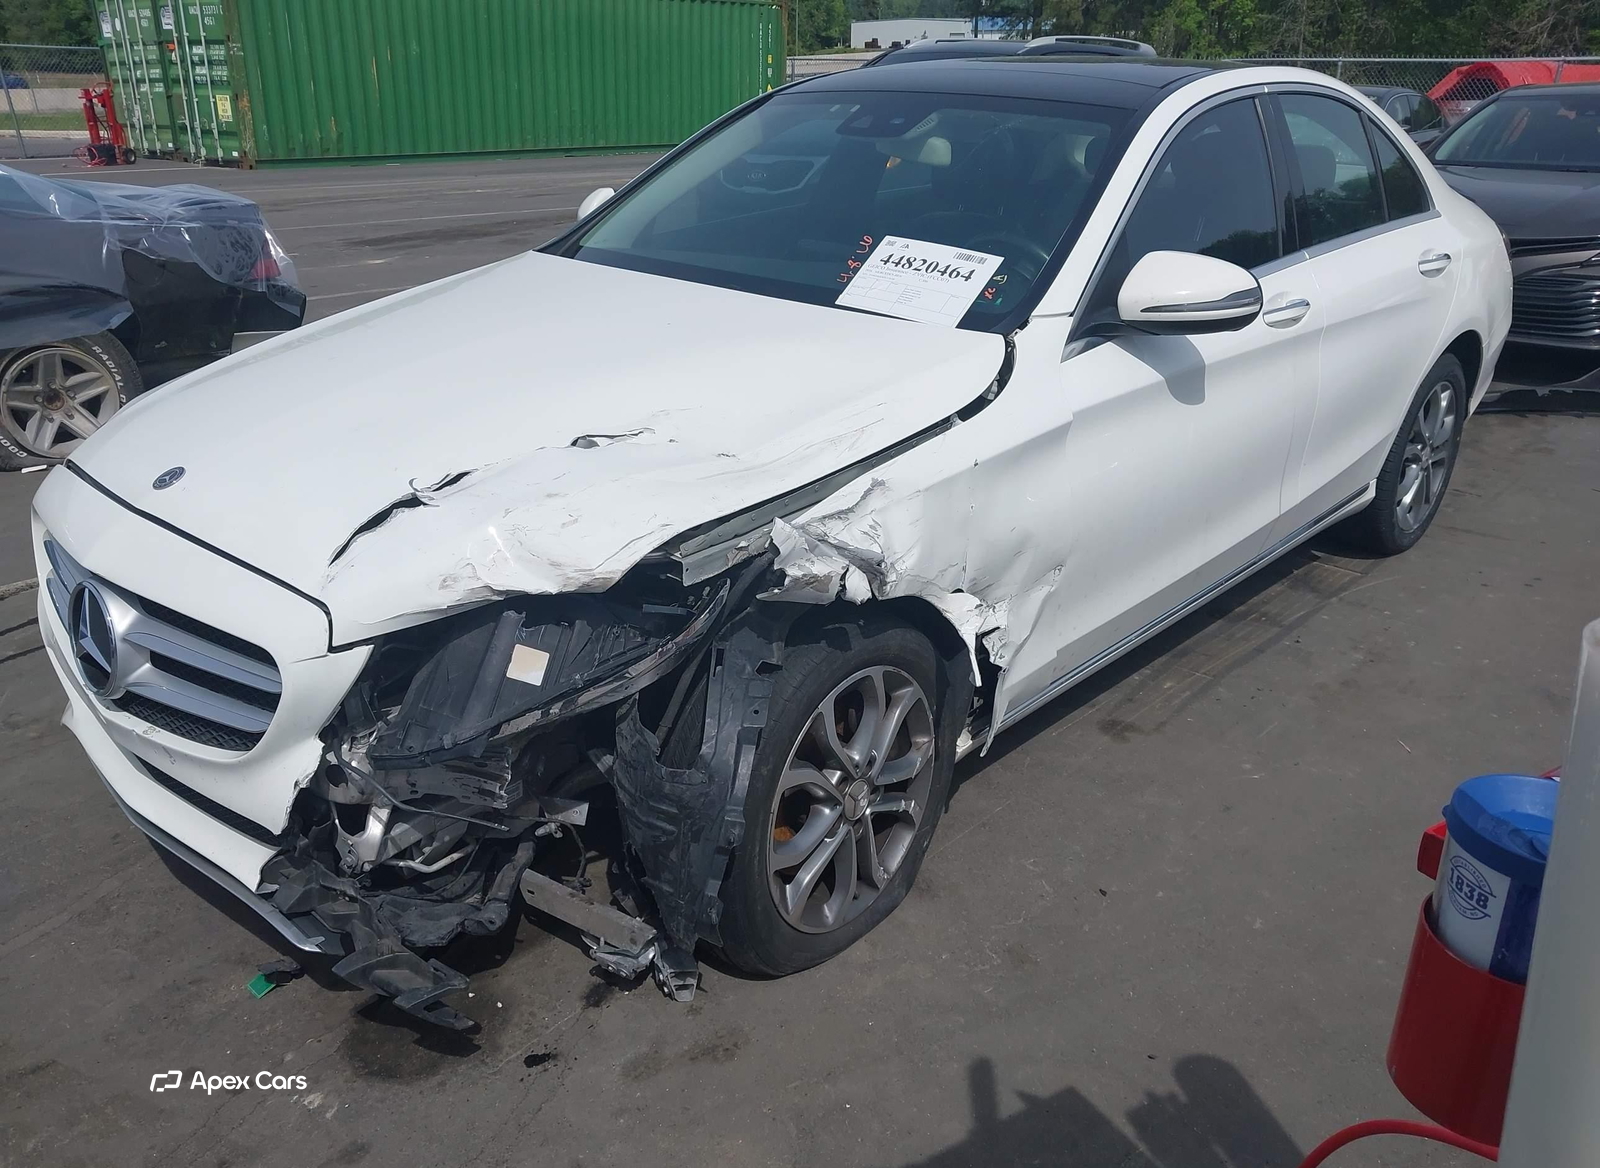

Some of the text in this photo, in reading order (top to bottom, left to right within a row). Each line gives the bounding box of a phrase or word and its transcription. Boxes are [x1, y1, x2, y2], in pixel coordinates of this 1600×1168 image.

[880, 253, 976, 282] 44820464
[91, 345, 125, 390] RADIAL
[0, 435, 27, 458] COO
[1450, 867, 1489, 910] 1838
